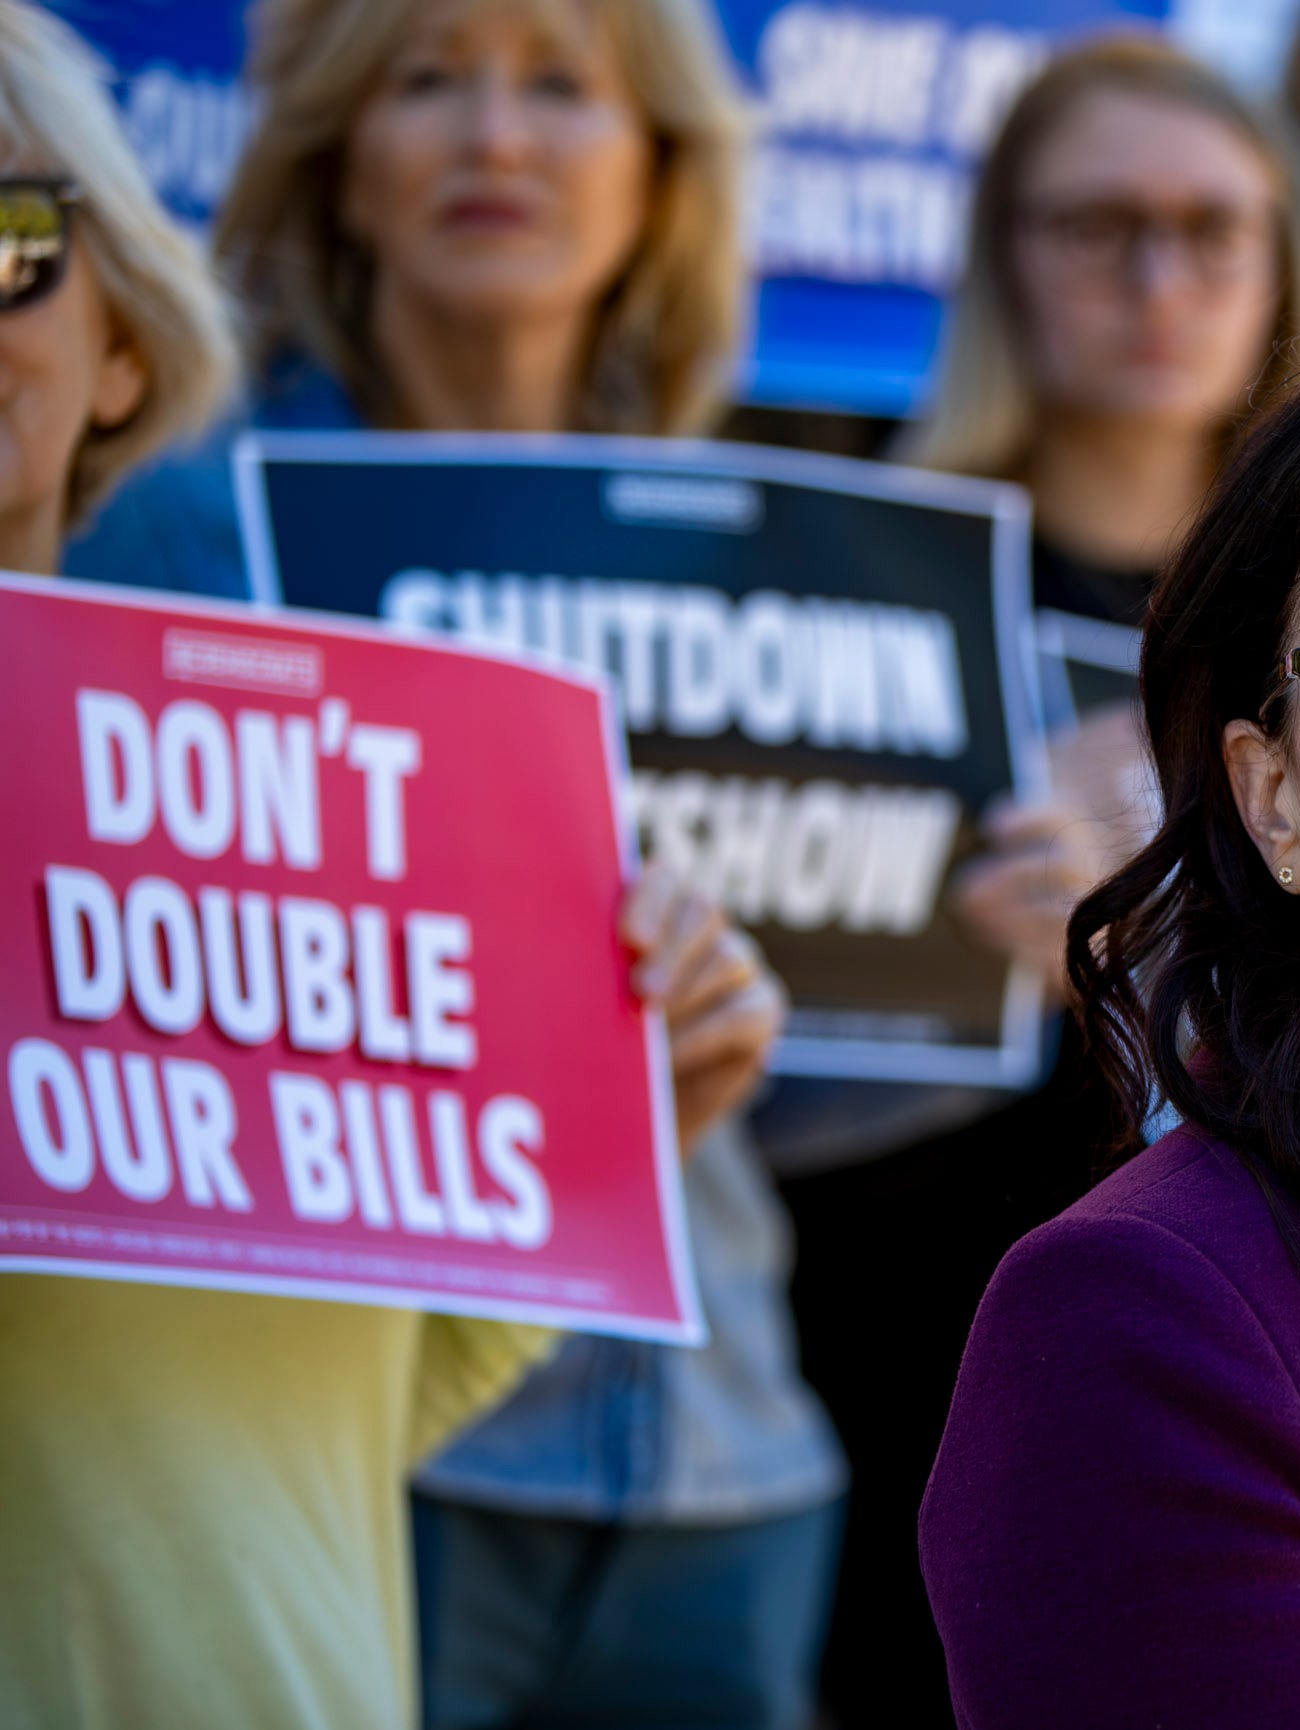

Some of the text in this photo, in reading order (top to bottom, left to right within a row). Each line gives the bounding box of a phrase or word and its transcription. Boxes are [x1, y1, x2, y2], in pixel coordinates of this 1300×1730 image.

[76, 686, 421, 882] DON'T
[632, 768, 962, 936] SHOW
[44, 863, 478, 1071] DOUBLE
[7, 1036, 554, 1252] OUR BILLS
